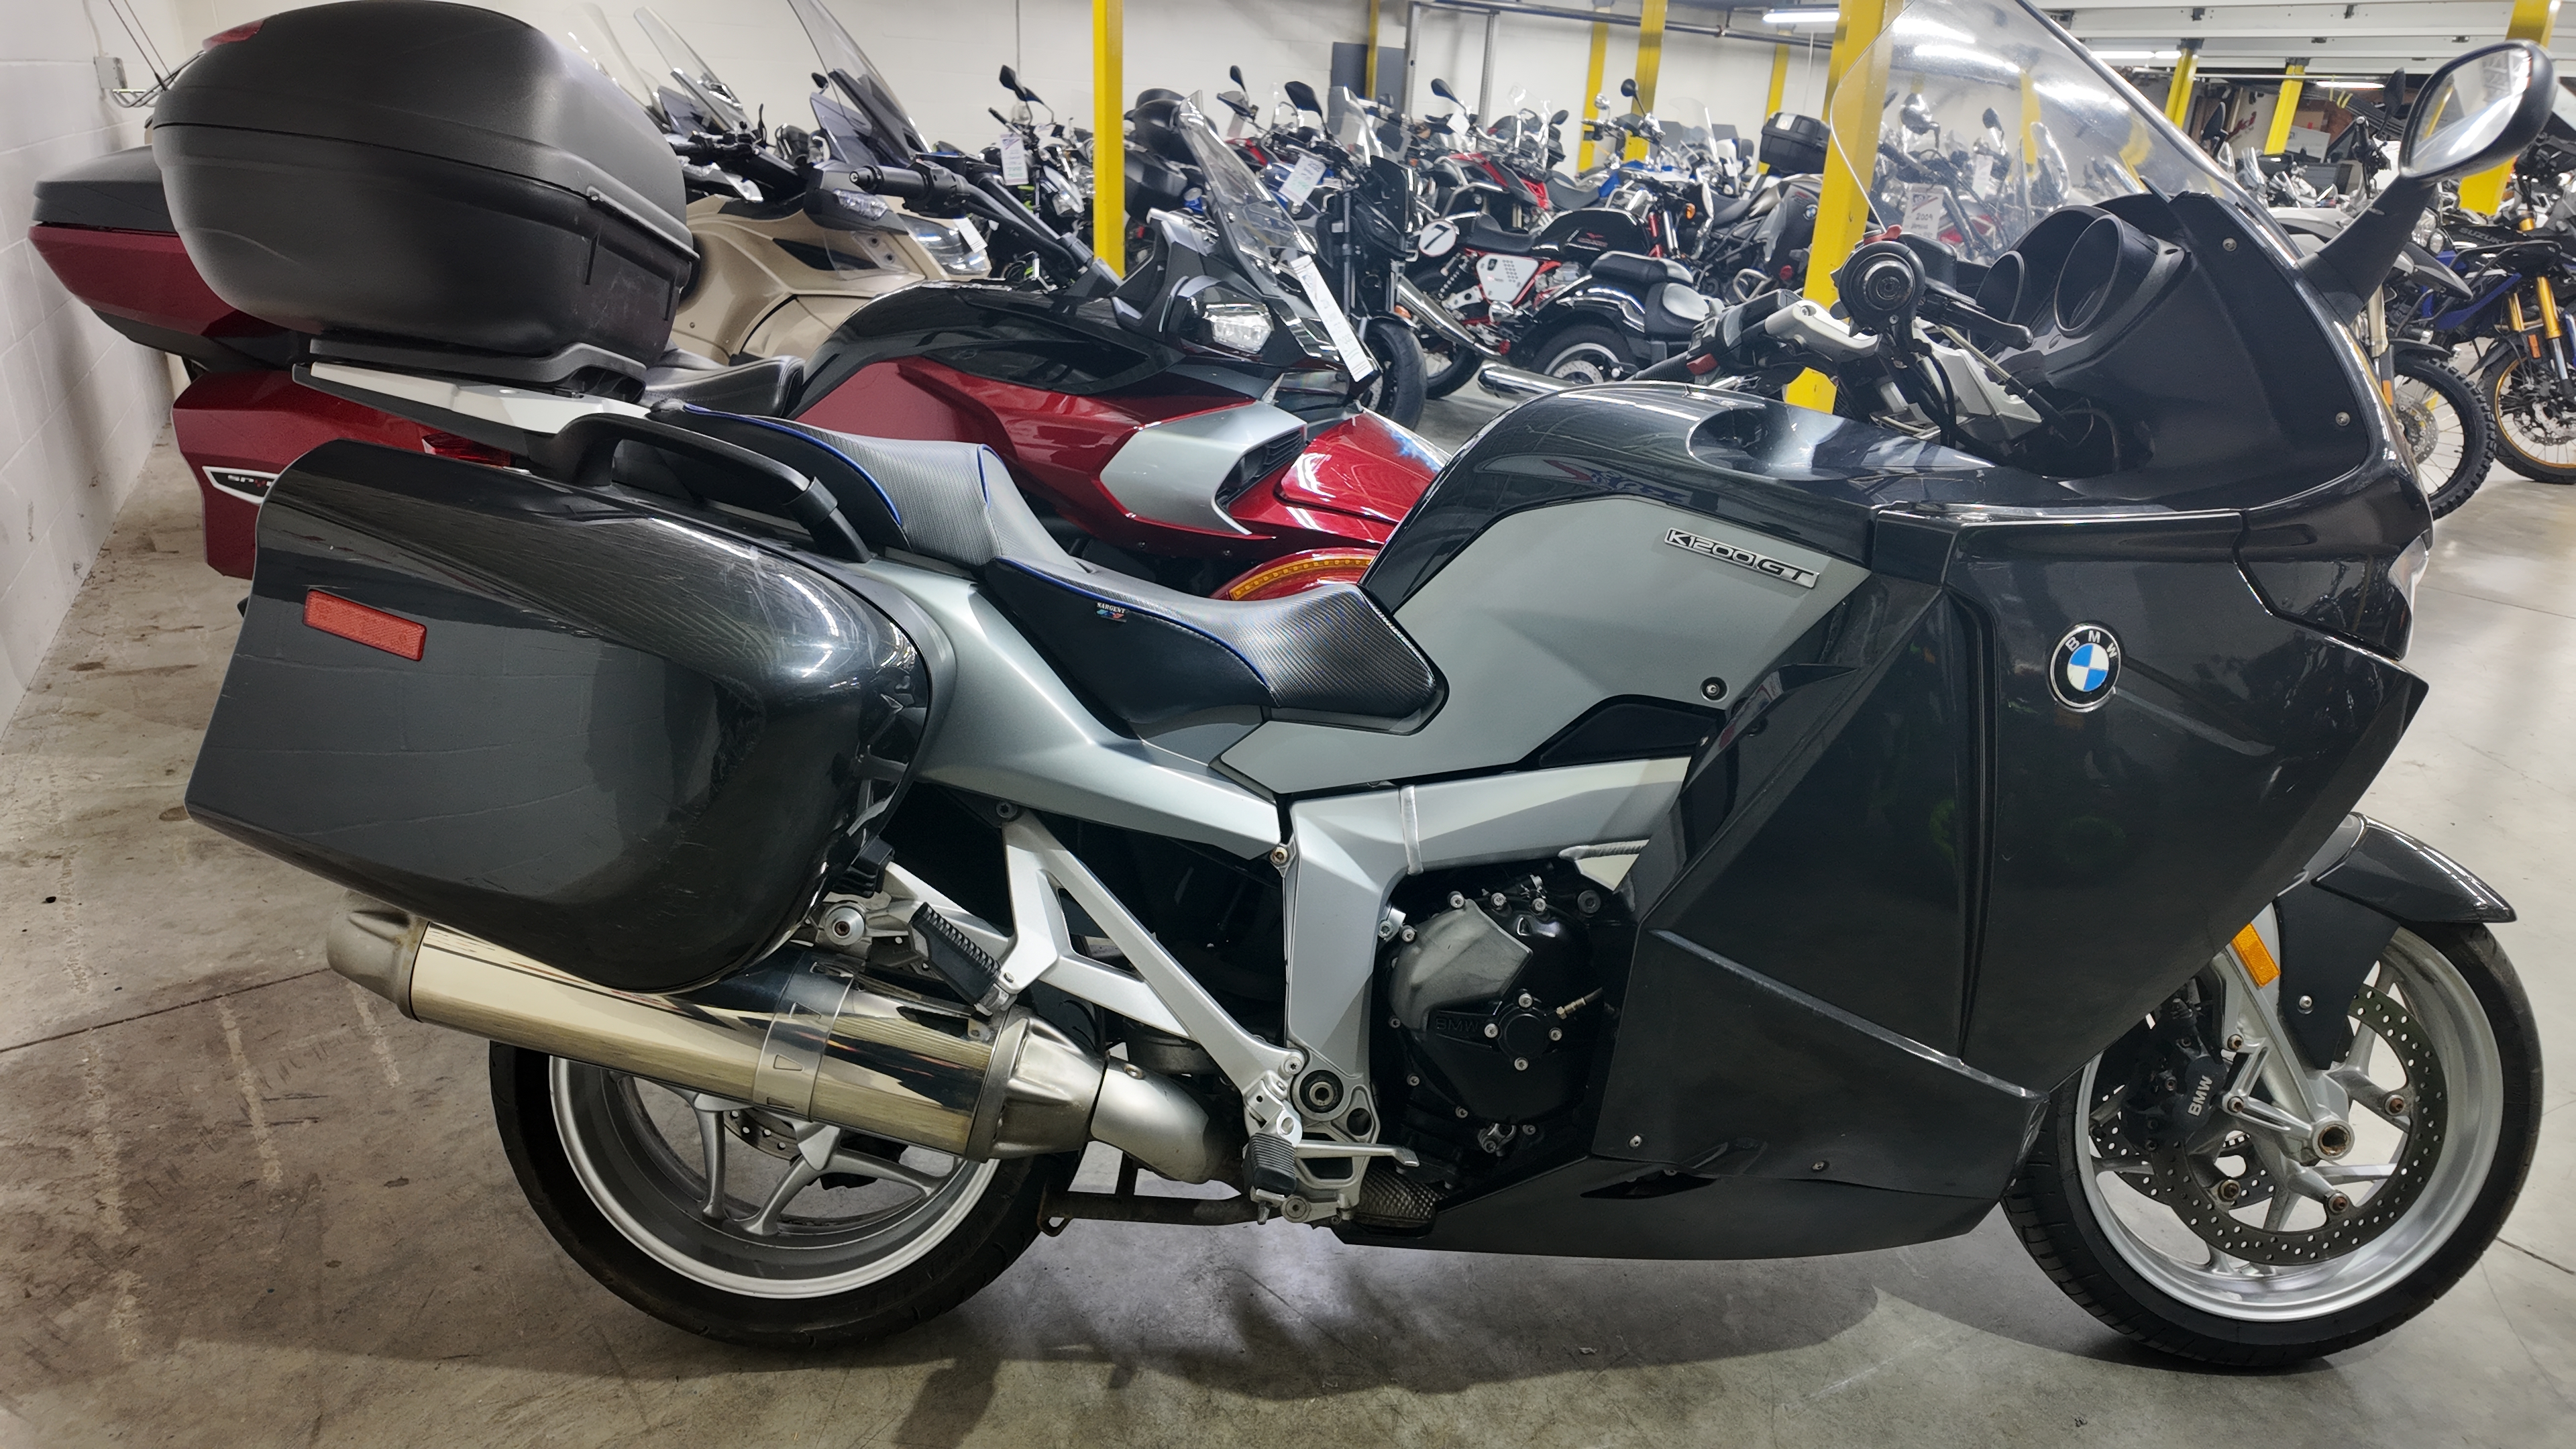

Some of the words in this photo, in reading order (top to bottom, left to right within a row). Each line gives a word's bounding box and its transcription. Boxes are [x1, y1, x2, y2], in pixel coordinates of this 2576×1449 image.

[1424, 224, 1450, 250] 7
[1097, 602, 1126, 613] SARGENT
[2065, 631, 2116, 658] BMW
[1436, 1018, 1479, 1032] BMW
[2188, 1075, 2212, 1116] BMW
